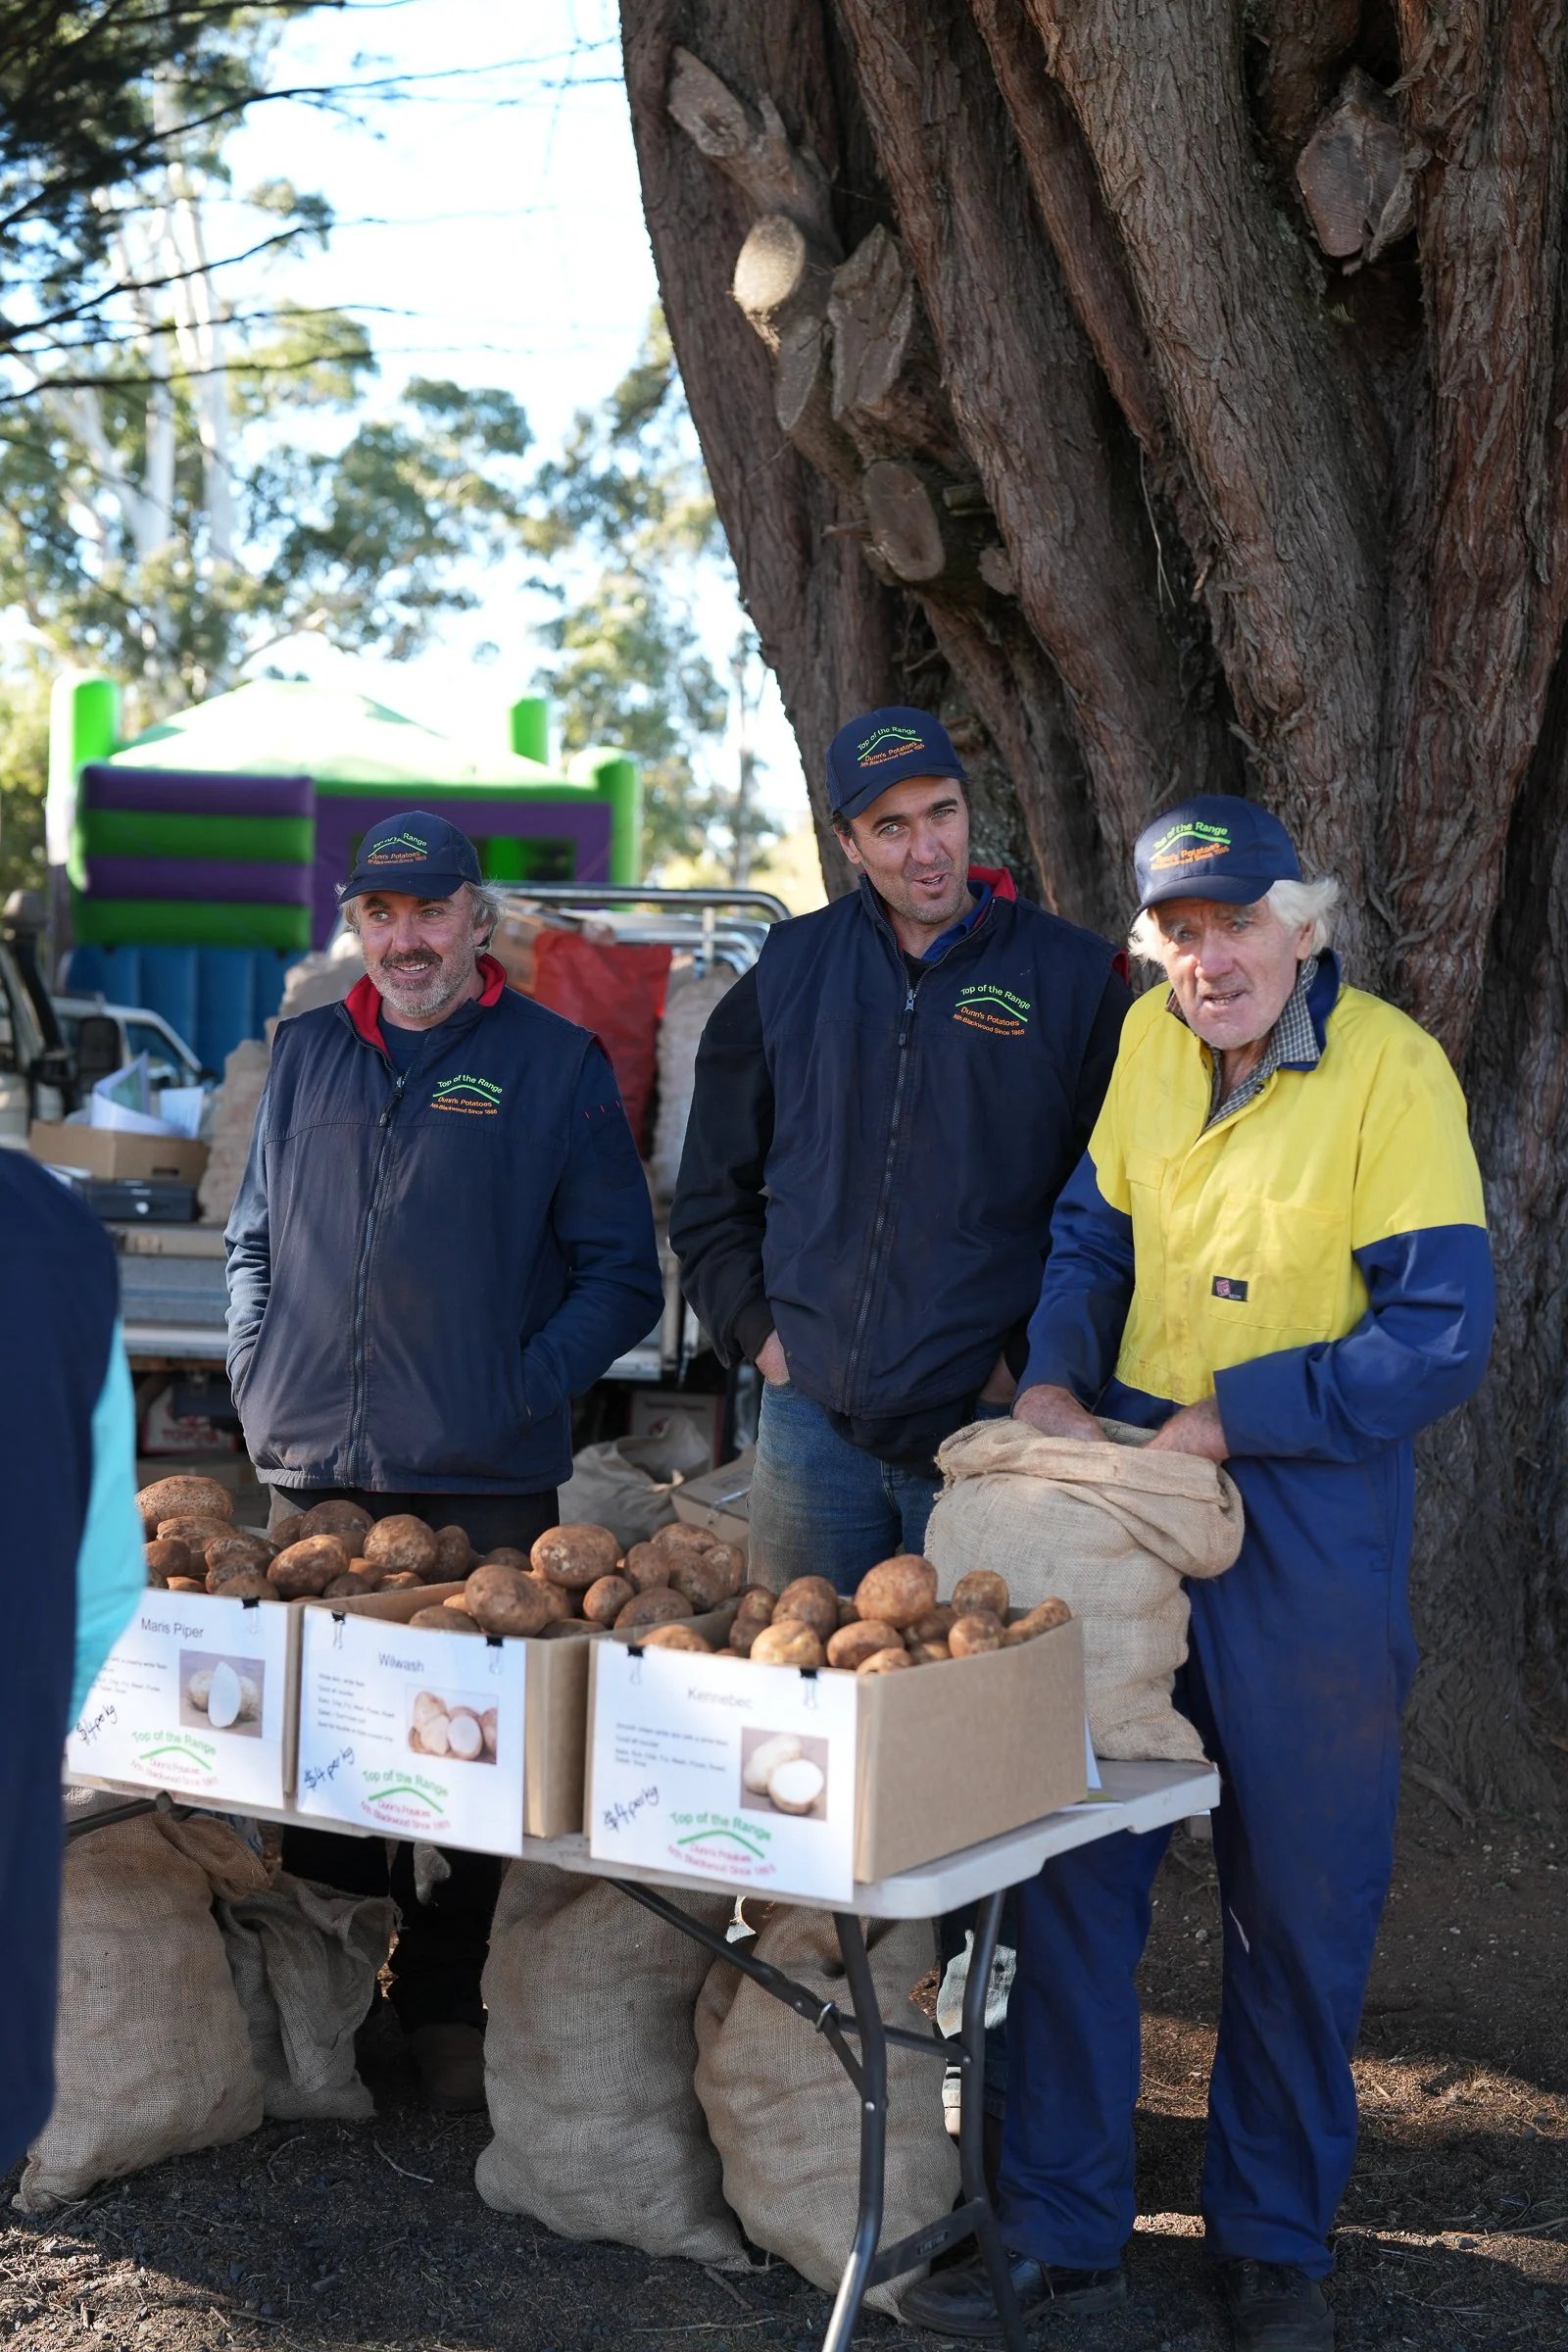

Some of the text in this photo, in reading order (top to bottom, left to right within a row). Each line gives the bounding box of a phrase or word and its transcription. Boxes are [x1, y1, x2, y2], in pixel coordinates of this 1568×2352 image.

[857, 726, 916, 751] Top of the Range
[888, 741, 917, 756] Potatoes
[403, 832, 427, 847] Range
[1167, 826, 1175, 839] of
[1175, 823, 1193, 834] the
[1196, 821, 1228, 836] Range
[390, 851, 420, 859] Potatoes
[960, 984, 1031, 1010] Top of the Range
[960, 1006, 1020, 1027] Dunn's Potatoes
[961, 1016, 994, 1033] Blackwood
[994, 1027, 1010, 1036] Since
[453, 1074, 462, 1083] of
[462, 1074, 477, 1084] the
[477, 1078, 503, 1094] Range
[461, 1099, 493, 1107] Potatoes
[140, 1617, 205, 1640] Maris Piper
[131, 1730, 217, 1756] Top of the Range
[362, 1769, 449, 1797] Top of the Range
[670, 1811, 772, 1841] Top of the Range
